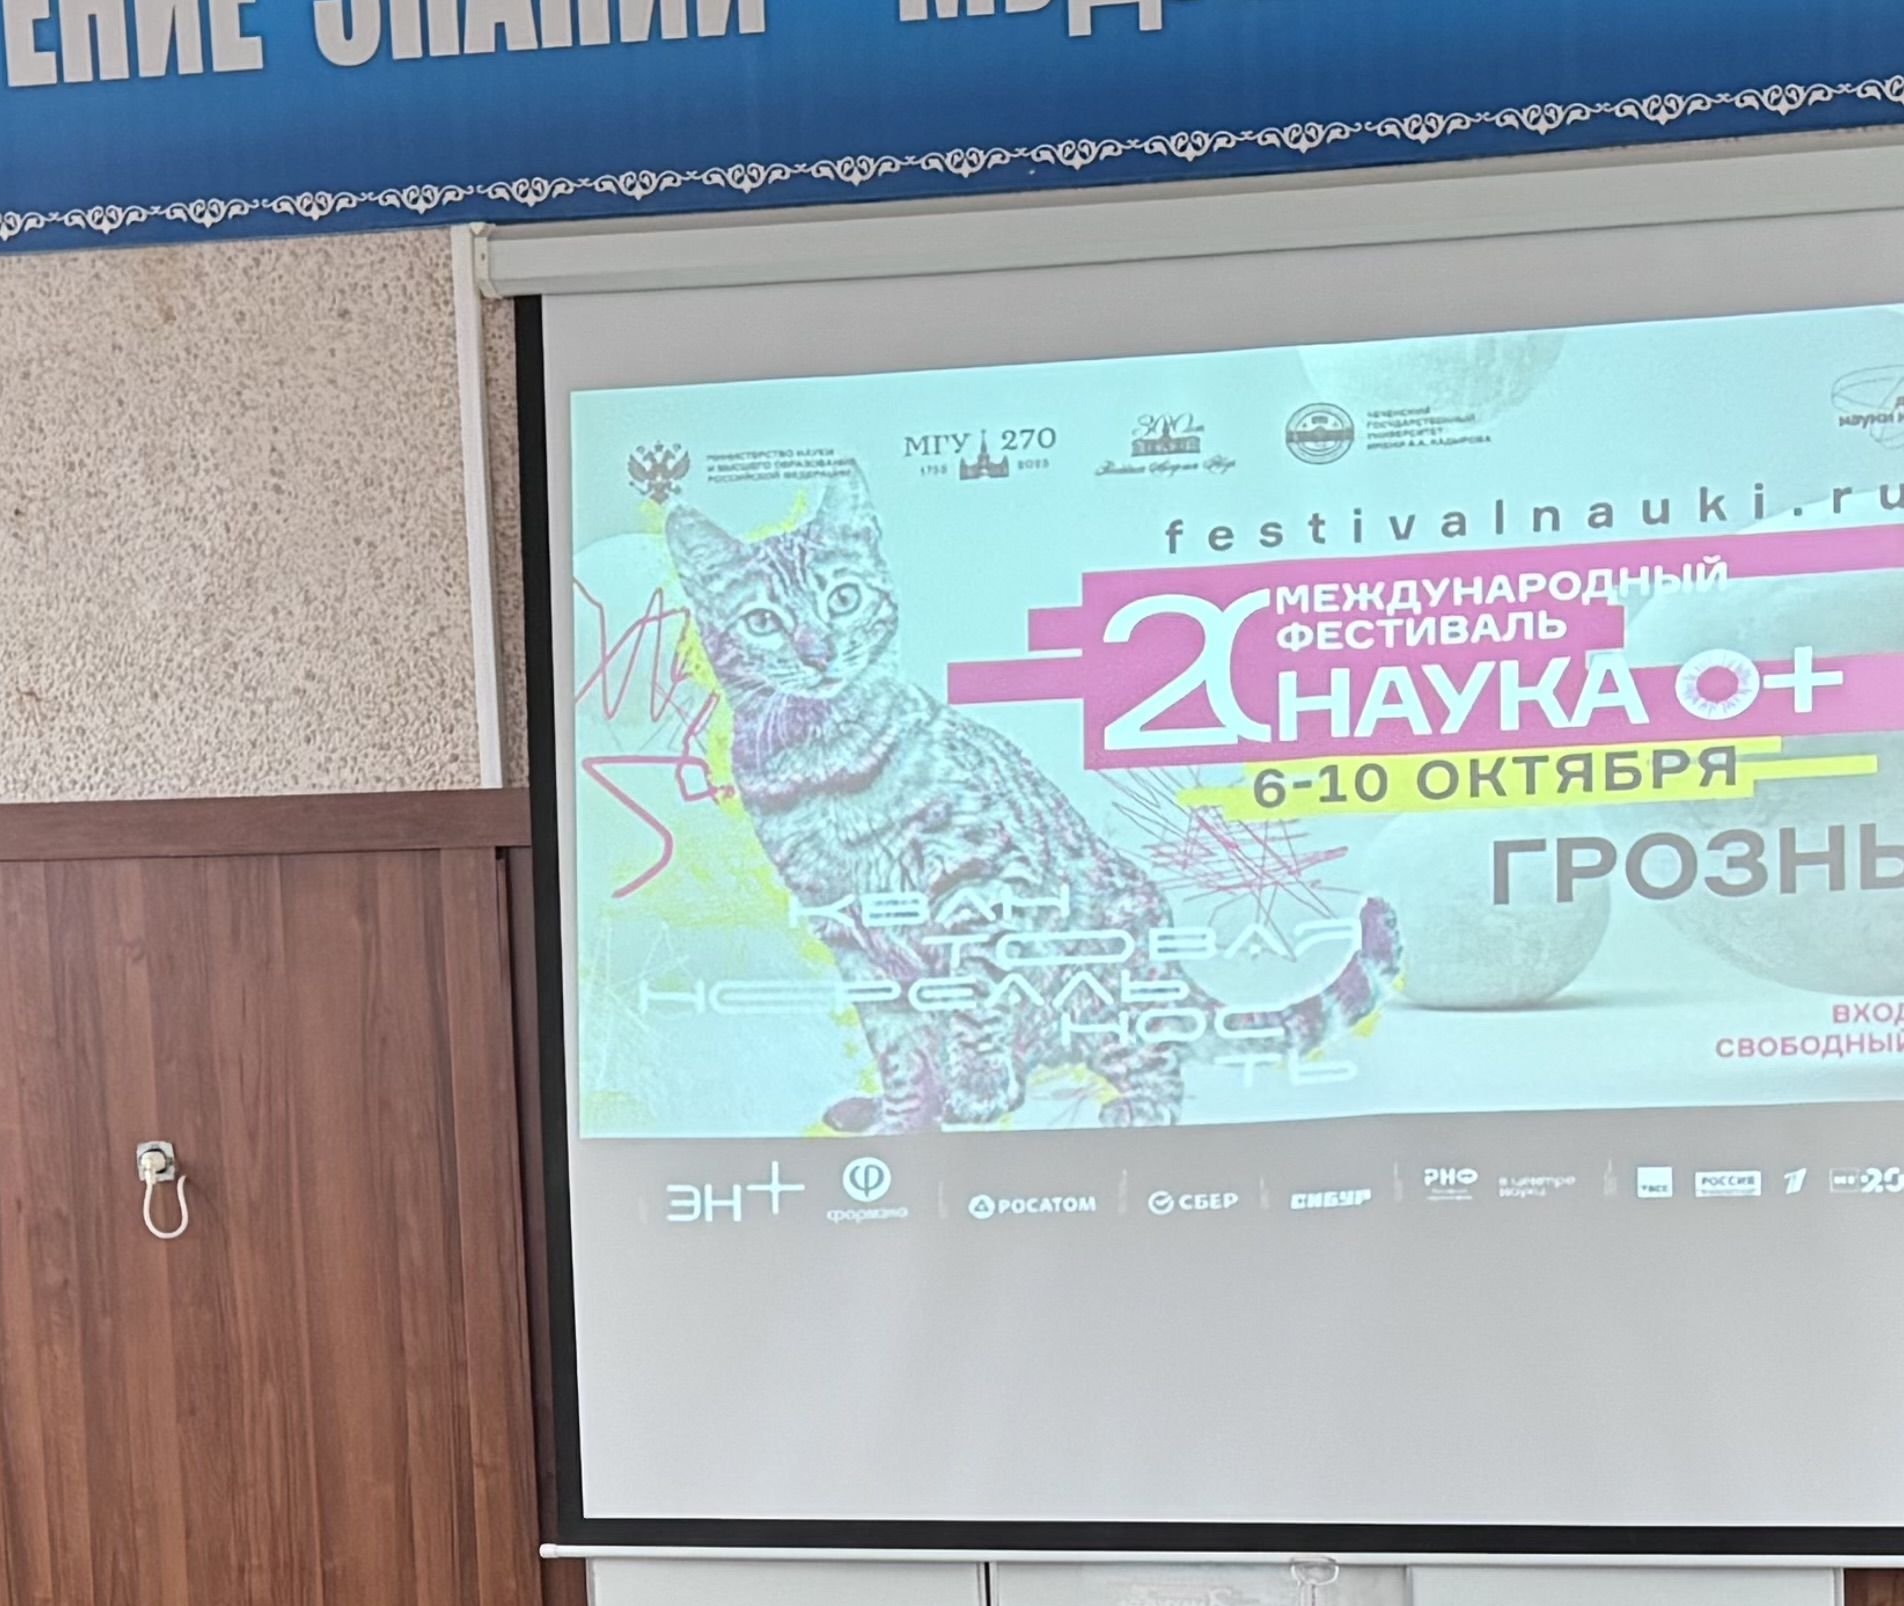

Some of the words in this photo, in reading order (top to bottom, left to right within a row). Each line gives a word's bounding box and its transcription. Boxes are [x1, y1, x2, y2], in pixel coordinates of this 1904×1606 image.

[904, 432, 971, 457] МГУ
[1001, 426, 1057, 450] 270
[1276, 554, 1728, 615] МЕЖДУНАРОДНЫЙ
[1276, 611, 1568, 652] ФЕСТИВАЛЬ
[1278, 653, 1649, 742] НАУКА
[1253, 762, 1389, 808] 6-10
[1416, 746, 1738, 799] ОКТЯБРЯ
[998, 1195, 1096, 1215] РОСАТОМ
[1179, 1191, 1239, 1210] СБЕР
